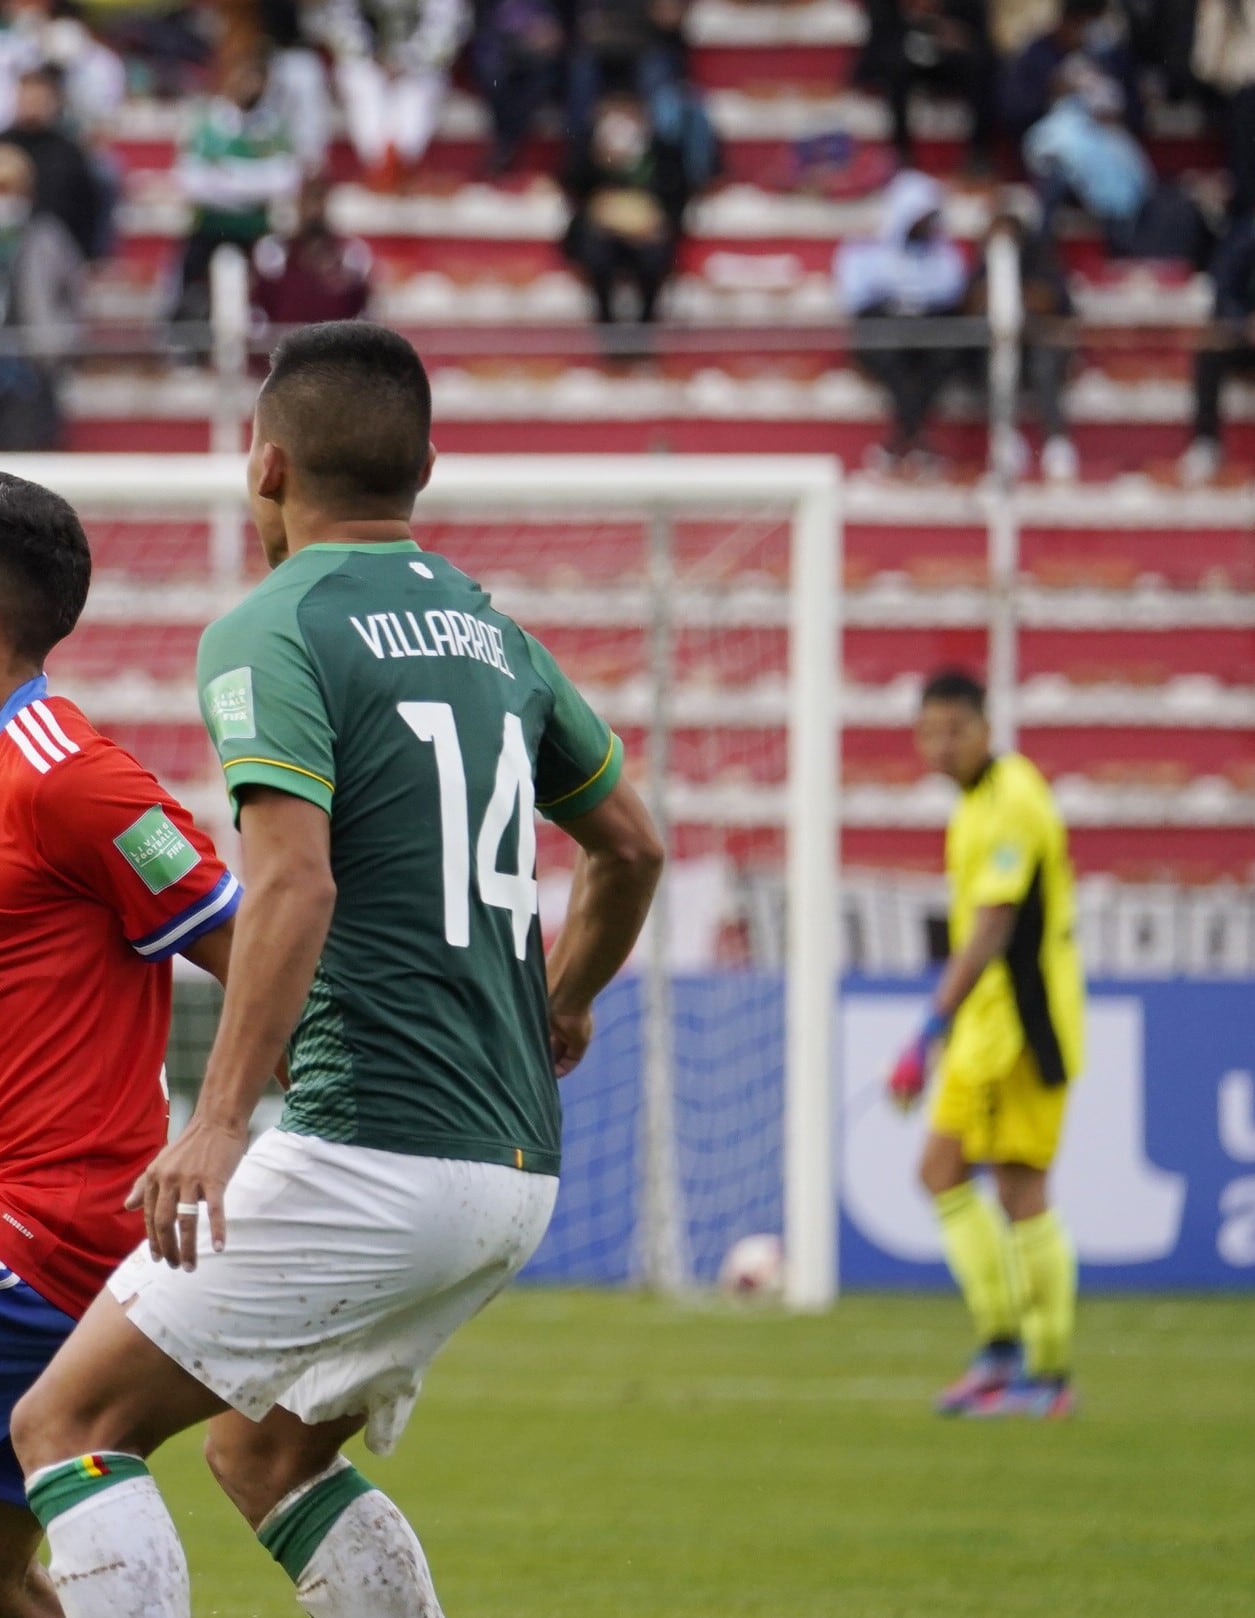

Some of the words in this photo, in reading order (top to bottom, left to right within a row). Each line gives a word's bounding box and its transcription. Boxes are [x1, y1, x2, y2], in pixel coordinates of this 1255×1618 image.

[350, 609, 516, 681] VILLARROEL
[130, 822, 169, 858] LIVING
[135, 829, 174, 864] FOOTBALL
[396, 701, 538, 961] 14
[166, 841, 185, 860] FIFA
